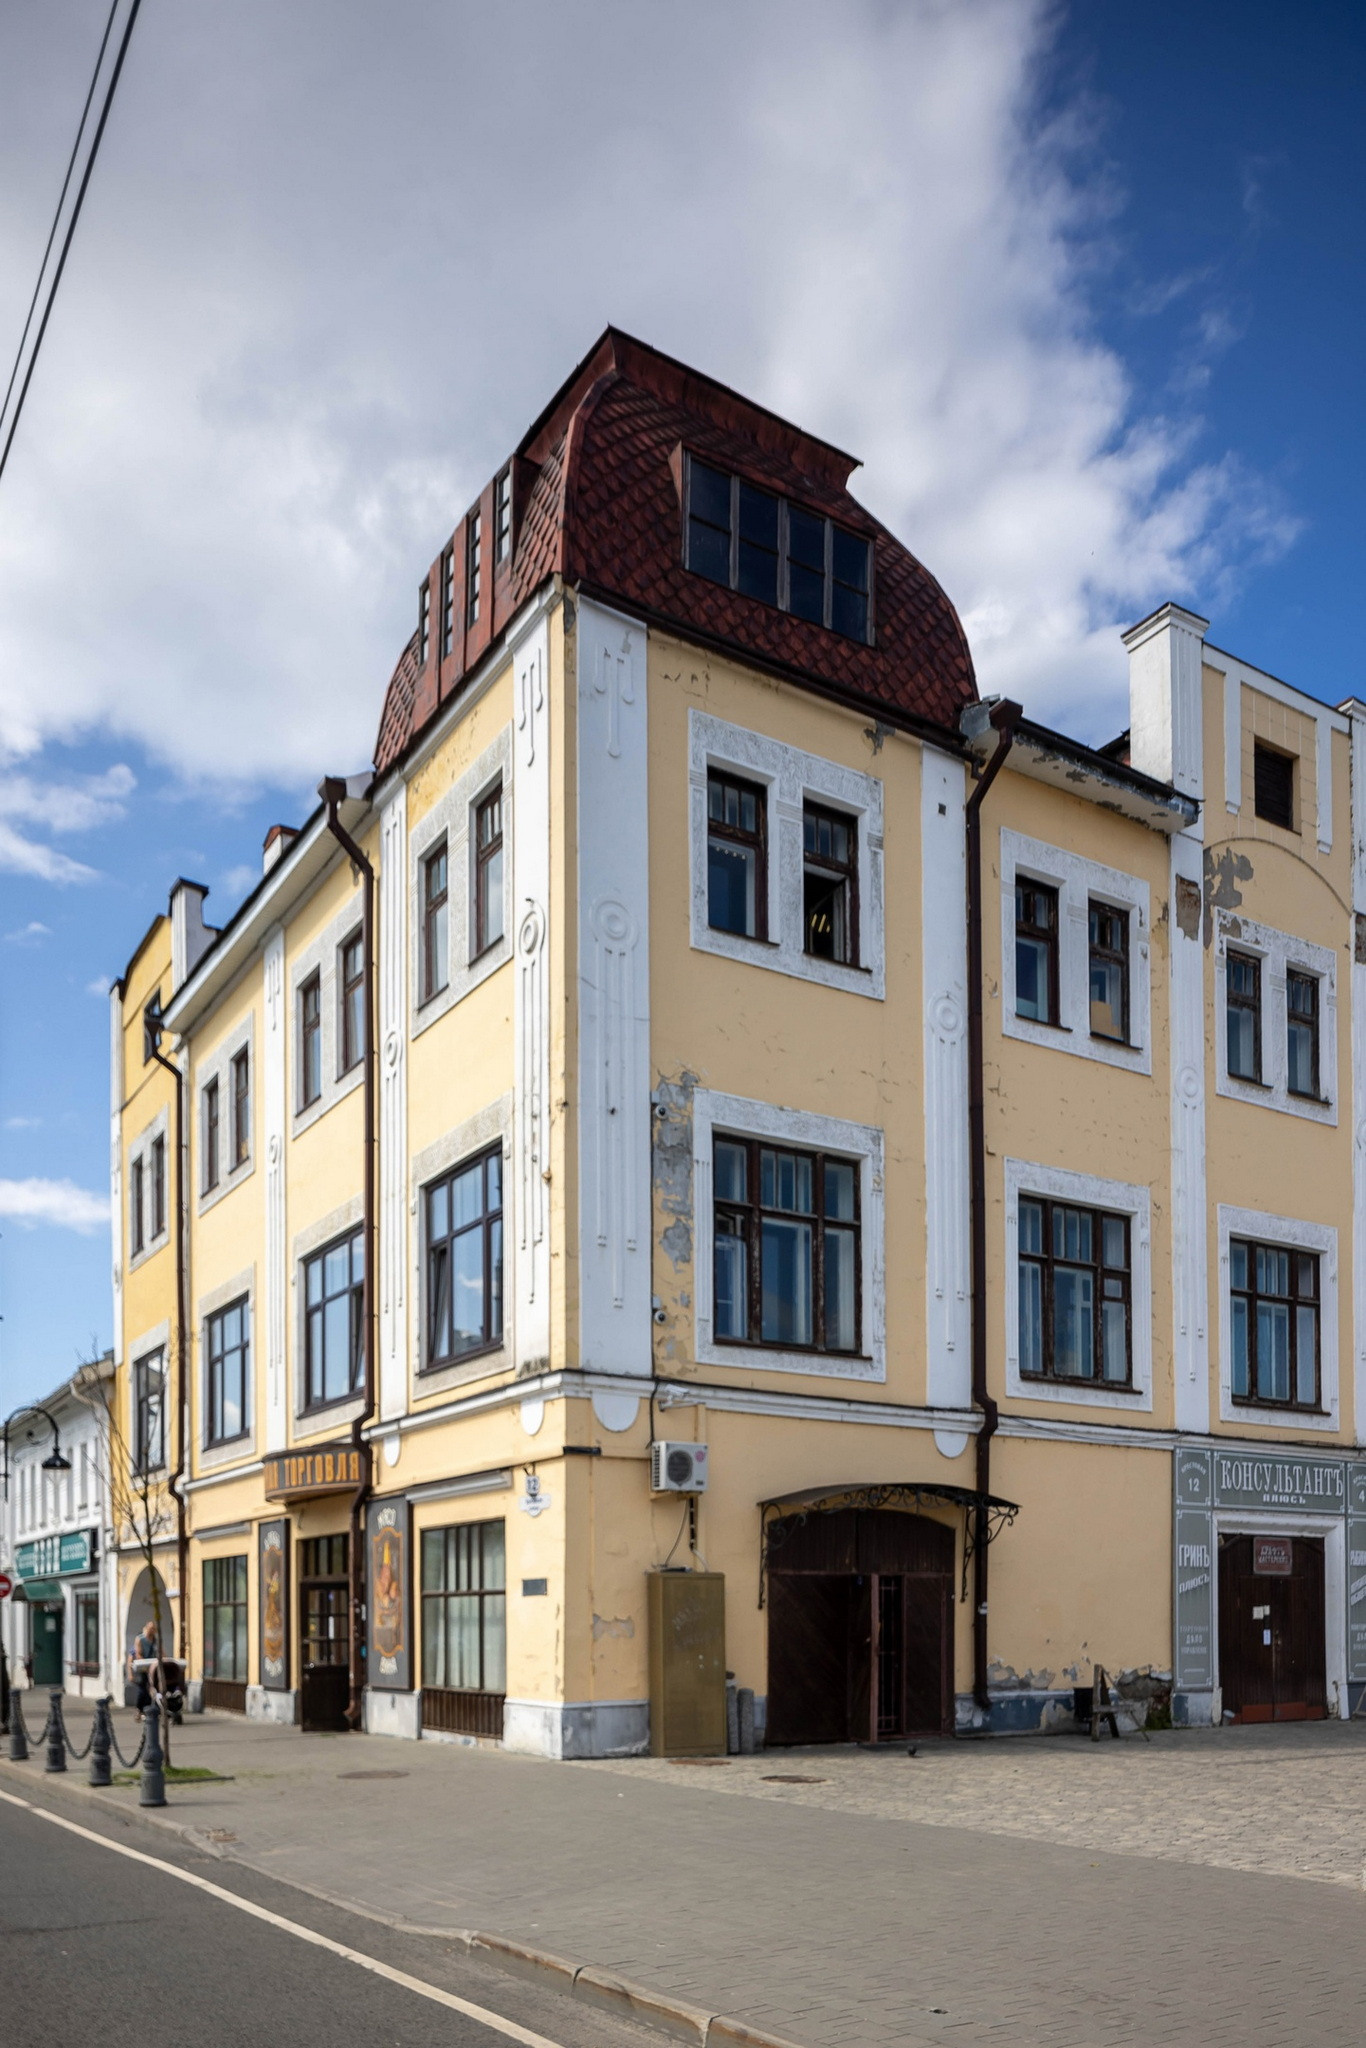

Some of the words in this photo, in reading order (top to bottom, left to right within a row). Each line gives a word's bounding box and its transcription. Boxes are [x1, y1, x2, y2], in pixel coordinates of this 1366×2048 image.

[284, 1450, 360, 1487] ТОРГОВЛЯ
[1220, 1459, 1343, 1497] КОНСУЛЬТАНТЪ
[1189, 1478, 1200, 1492] 12
[1262, 1494, 1306, 1505] ПЛЮСЪ
[1179, 1544, 1210, 1568] ГРИНЪ
